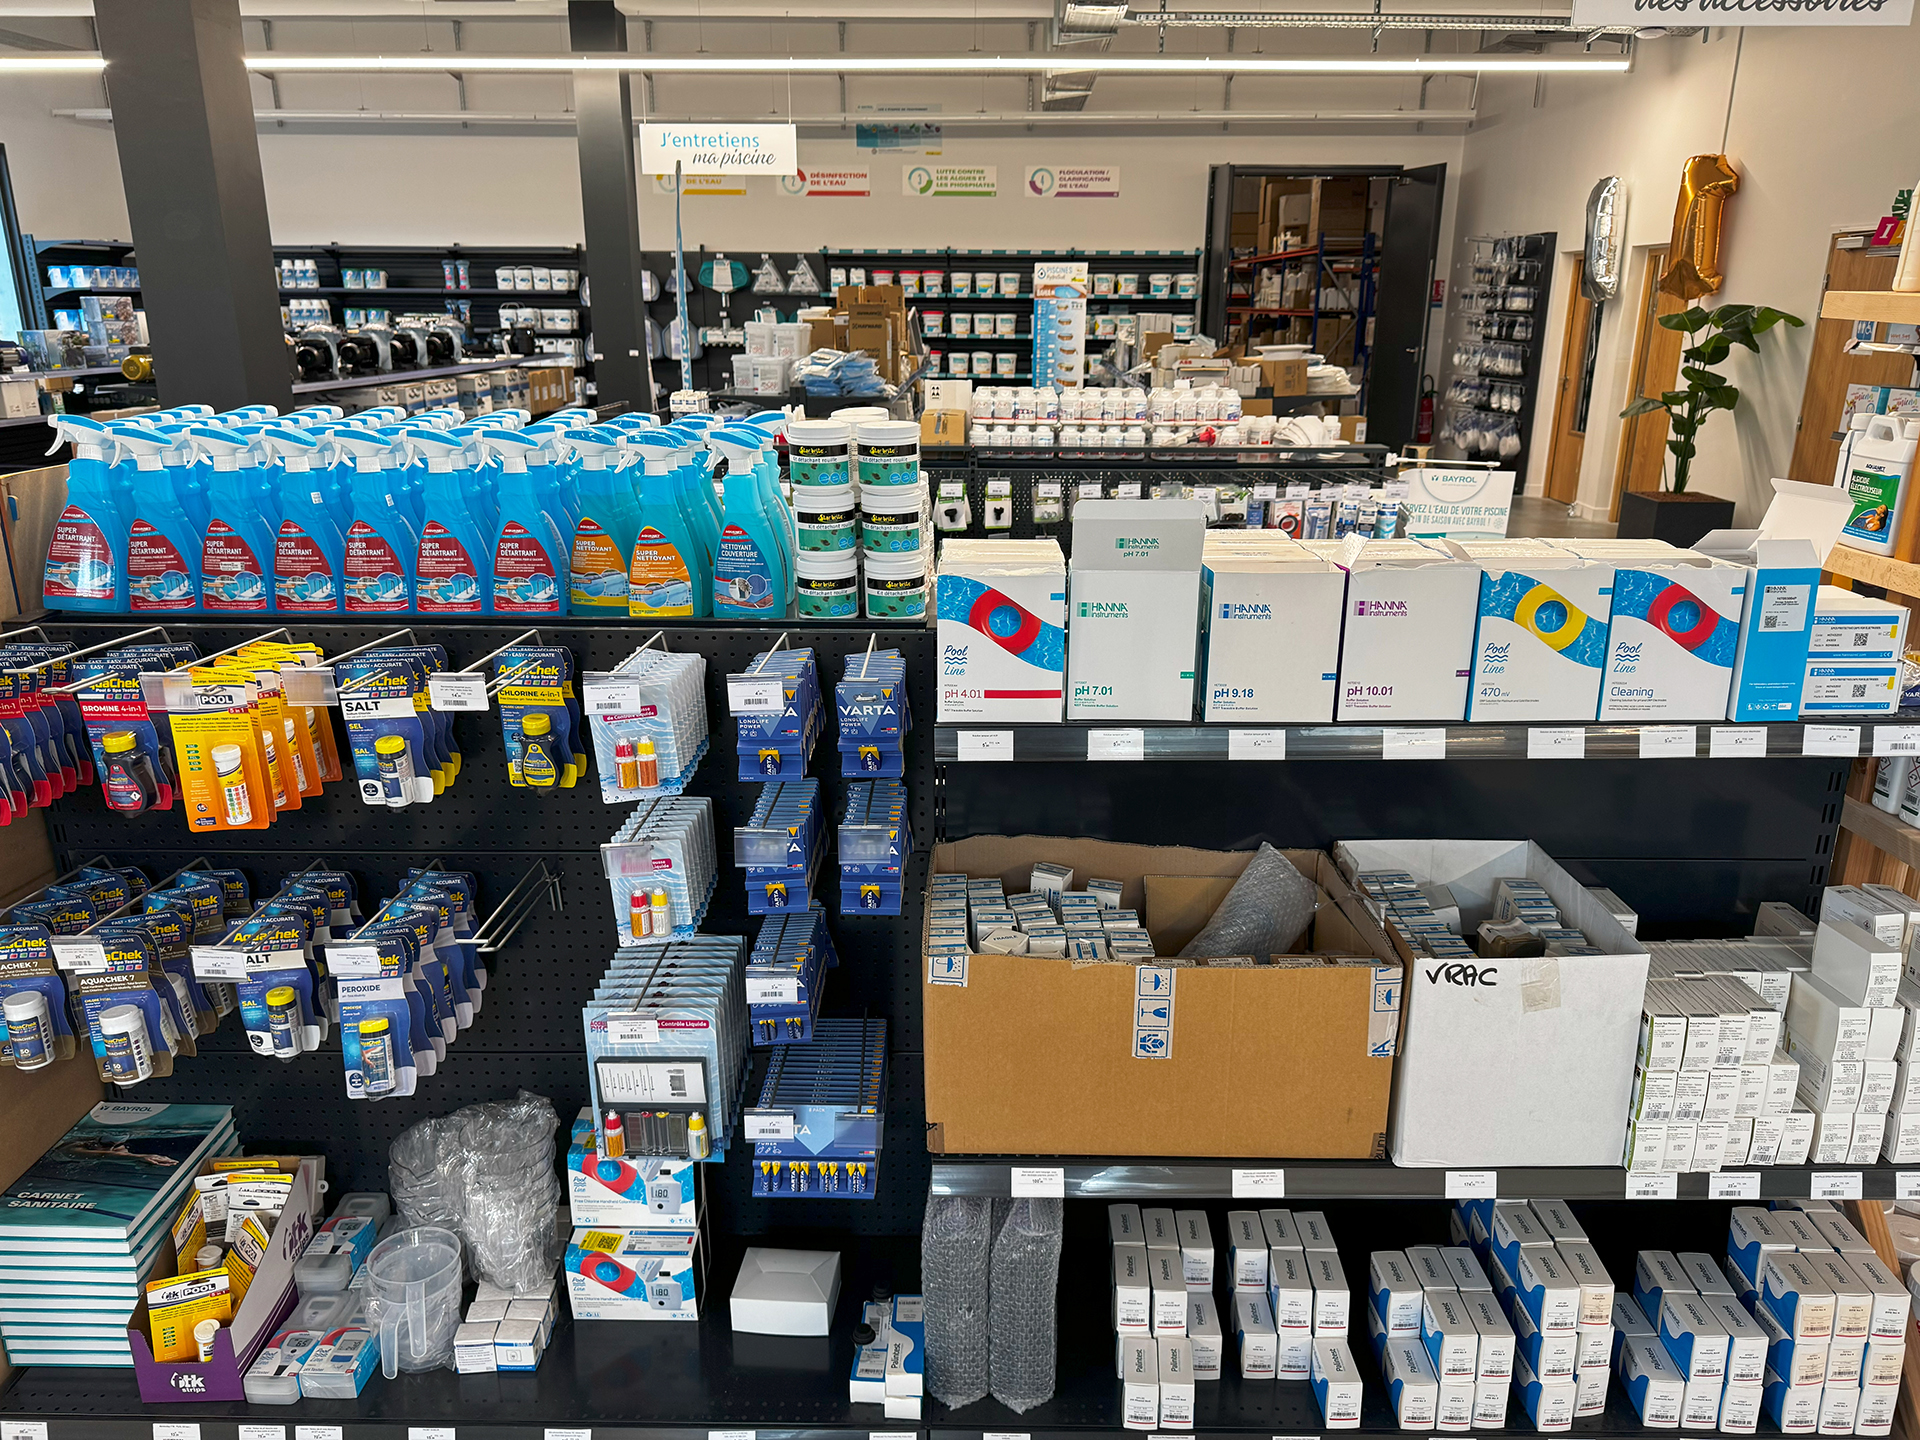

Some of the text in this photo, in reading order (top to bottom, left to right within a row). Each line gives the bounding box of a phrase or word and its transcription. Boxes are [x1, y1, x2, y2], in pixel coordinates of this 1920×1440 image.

[660, 131, 760, 148] J'entretiens
[692, 148, 776, 168] ma piscine
[810, 171, 868, 180] DÉSINFECTION
[1442, 475, 1477, 483] BAYROL
[1428, 505, 1508, 516] L'EAU DE VOTRE PISCINE
[1431, 515, 1450, 525] SAISON
[1452, 517, 1465, 526] AVEC
[1466, 517, 1486, 526] BAYROL
[57, 526, 78, 535] SUPER
[57, 533, 96, 543] DÉTARTRANT
[1128, 537, 1159, 545] HANNA
[130, 541, 148, 549] SUPER
[206, 540, 224, 548] SUPER
[278, 541, 295, 549] SUPER
[721, 543, 752, 551] NETTOYANT
[131, 547, 166, 555] DÉTARTRANT
[207, 547, 242, 555] DÉTARTRANT
[279, 547, 312, 556] DÉTARTRANT
[349, 548, 384, 556] DÉTARTRANT
[422, 549, 457, 557] DÉTARTRANT
[500, 549, 537, 557] DÉTARTRANT
[721, 550, 758, 558] COUVERTURE
[1091, 602, 1128, 611] HANNA
[1234, 603, 1272, 613] HANNA
[1369, 601, 1407, 610] HANNA
[1091, 610, 1128, 619] instruments
[1234, 612, 1272, 620] instruments
[1369, 609, 1408, 617] instruments
[944, 644, 968, 657] Pool
[1483, 641, 1510, 655] Pool
[1615, 641, 1641, 655] Pool
[944, 665, 966, 676] Line
[1482, 662, 1506, 675] Line
[1613, 663, 1637, 675] Line
[540, 690, 560, 698] 4-in-1
[944, 689, 982, 700] pH 4.01
[1074, 686, 1113, 697] pH 7.01
[1214, 688, 1254, 699] pH 9.18
[1347, 685, 1393, 697] pH 10.01
[1480, 687, 1500, 697] 470
[1610, 686, 1654, 699] Cleaning
[202, 695, 233, 704] POOL
[82, 704, 142, 713] BROMINE 4-in-1
[345, 701, 381, 712] SALT
[838, 705, 896, 716] VARTA
[146, 913, 171, 921] ACCURATE
[246, 953, 271, 965] ALT
[1426, 963, 1498, 987] VRAC
[80, 975, 128, 986] AQUACHEK
[341, 984, 381, 994] PEROXIDE
[685, 1020, 707, 1028] Liquide
[112, 1105, 152, 1113] BAYROL
[17, 1191, 84, 1200] CARNET
[7, 1199, 97, 1210] SANITAIRE
[1242, 1220, 1250, 1240] Palintest
[1308, 1220, 1318, 1240] Palintest
[1285, 1259, 1295, 1280] Palintest
[1320, 1260, 1330, 1281] Palintest
[1388, 1261, 1403, 1282] Palintest
[184, 1284, 215, 1296] POOL
[1249, 1302, 1259, 1324] Palintest
[890, 1341, 901, 1370] Palintest
[1330, 1348, 1343, 1372] Palintest
[181, 1386, 206, 1394] strips
